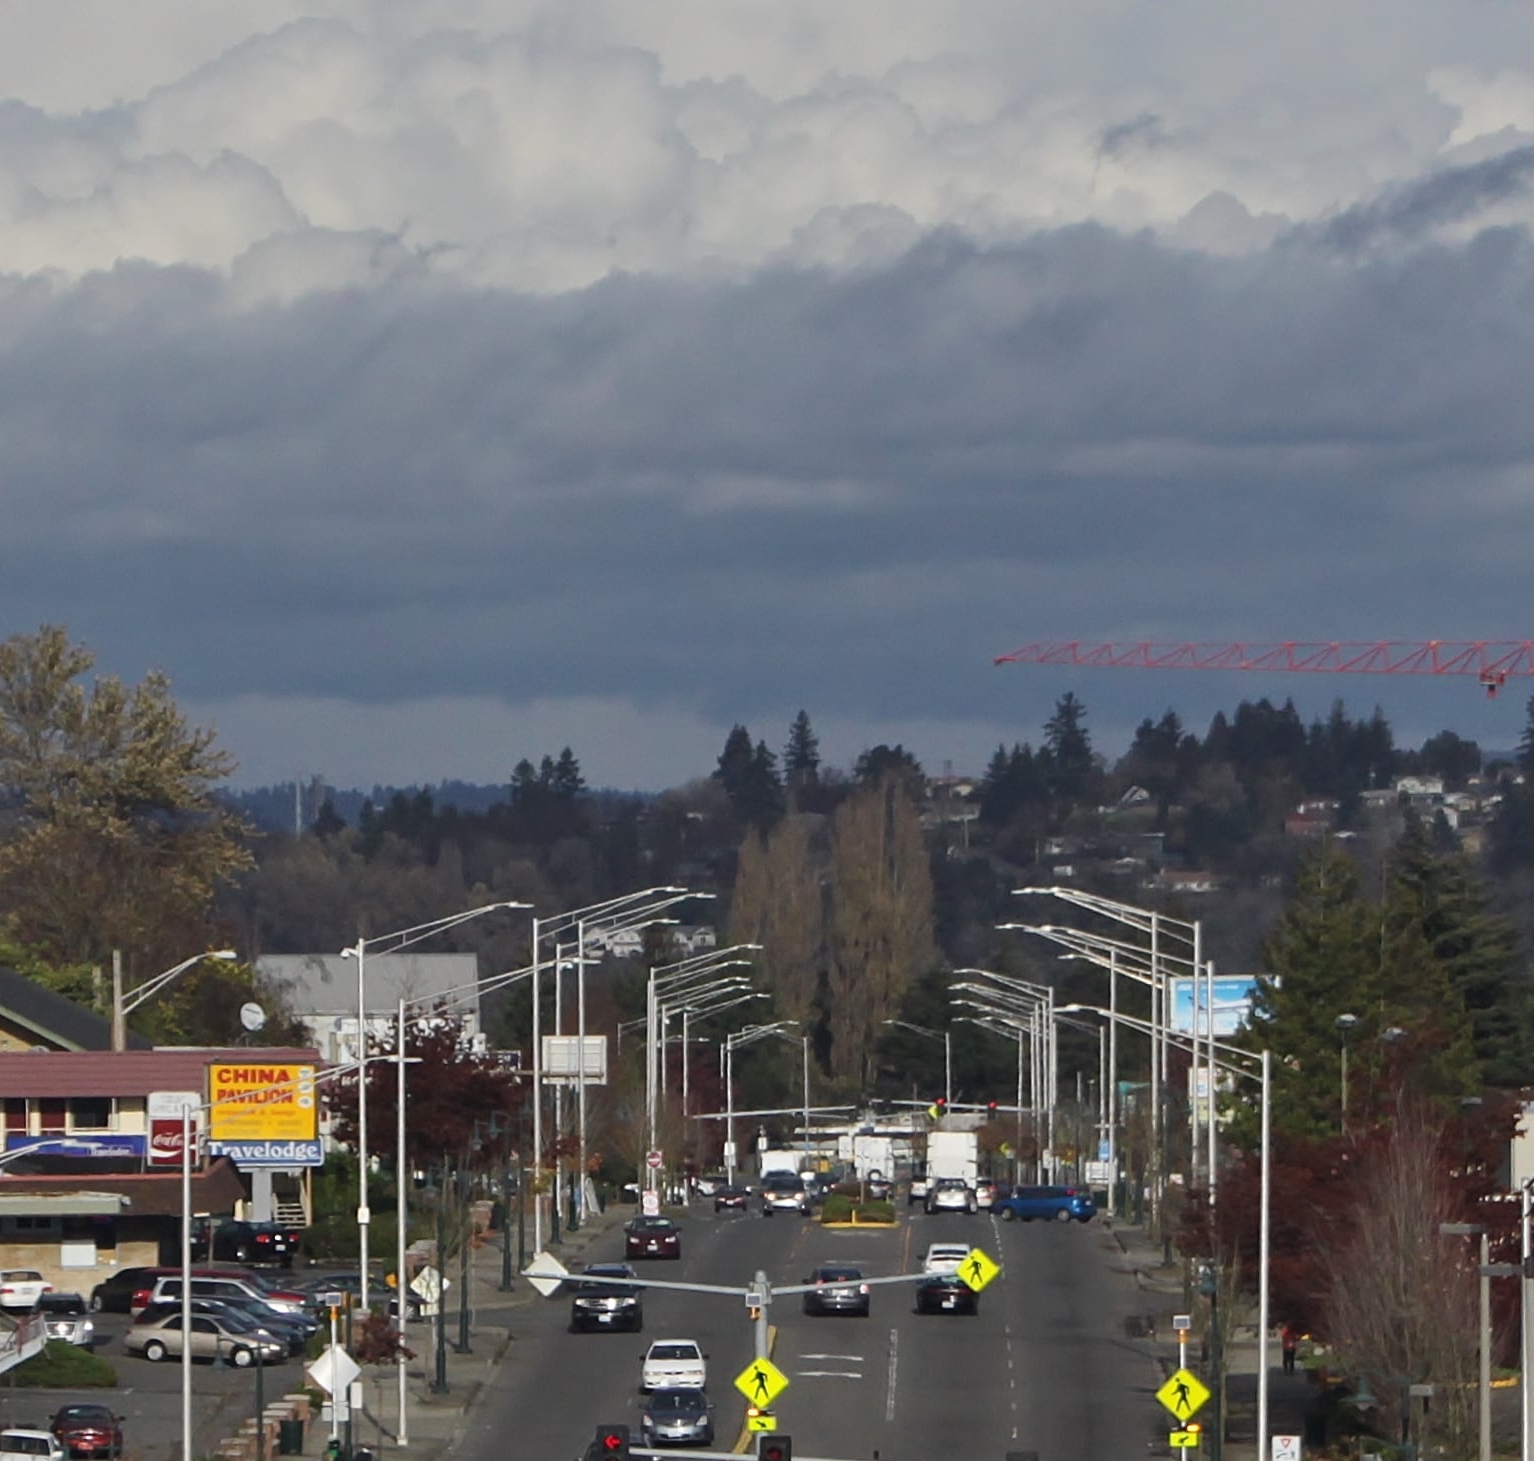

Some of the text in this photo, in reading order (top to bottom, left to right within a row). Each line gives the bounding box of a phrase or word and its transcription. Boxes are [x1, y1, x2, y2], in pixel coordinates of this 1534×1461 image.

[216, 1068, 290, 1084] CHINA
[216, 1088, 293, 1105] PAVILION
[207, 1141, 319, 1161] Travelodge
